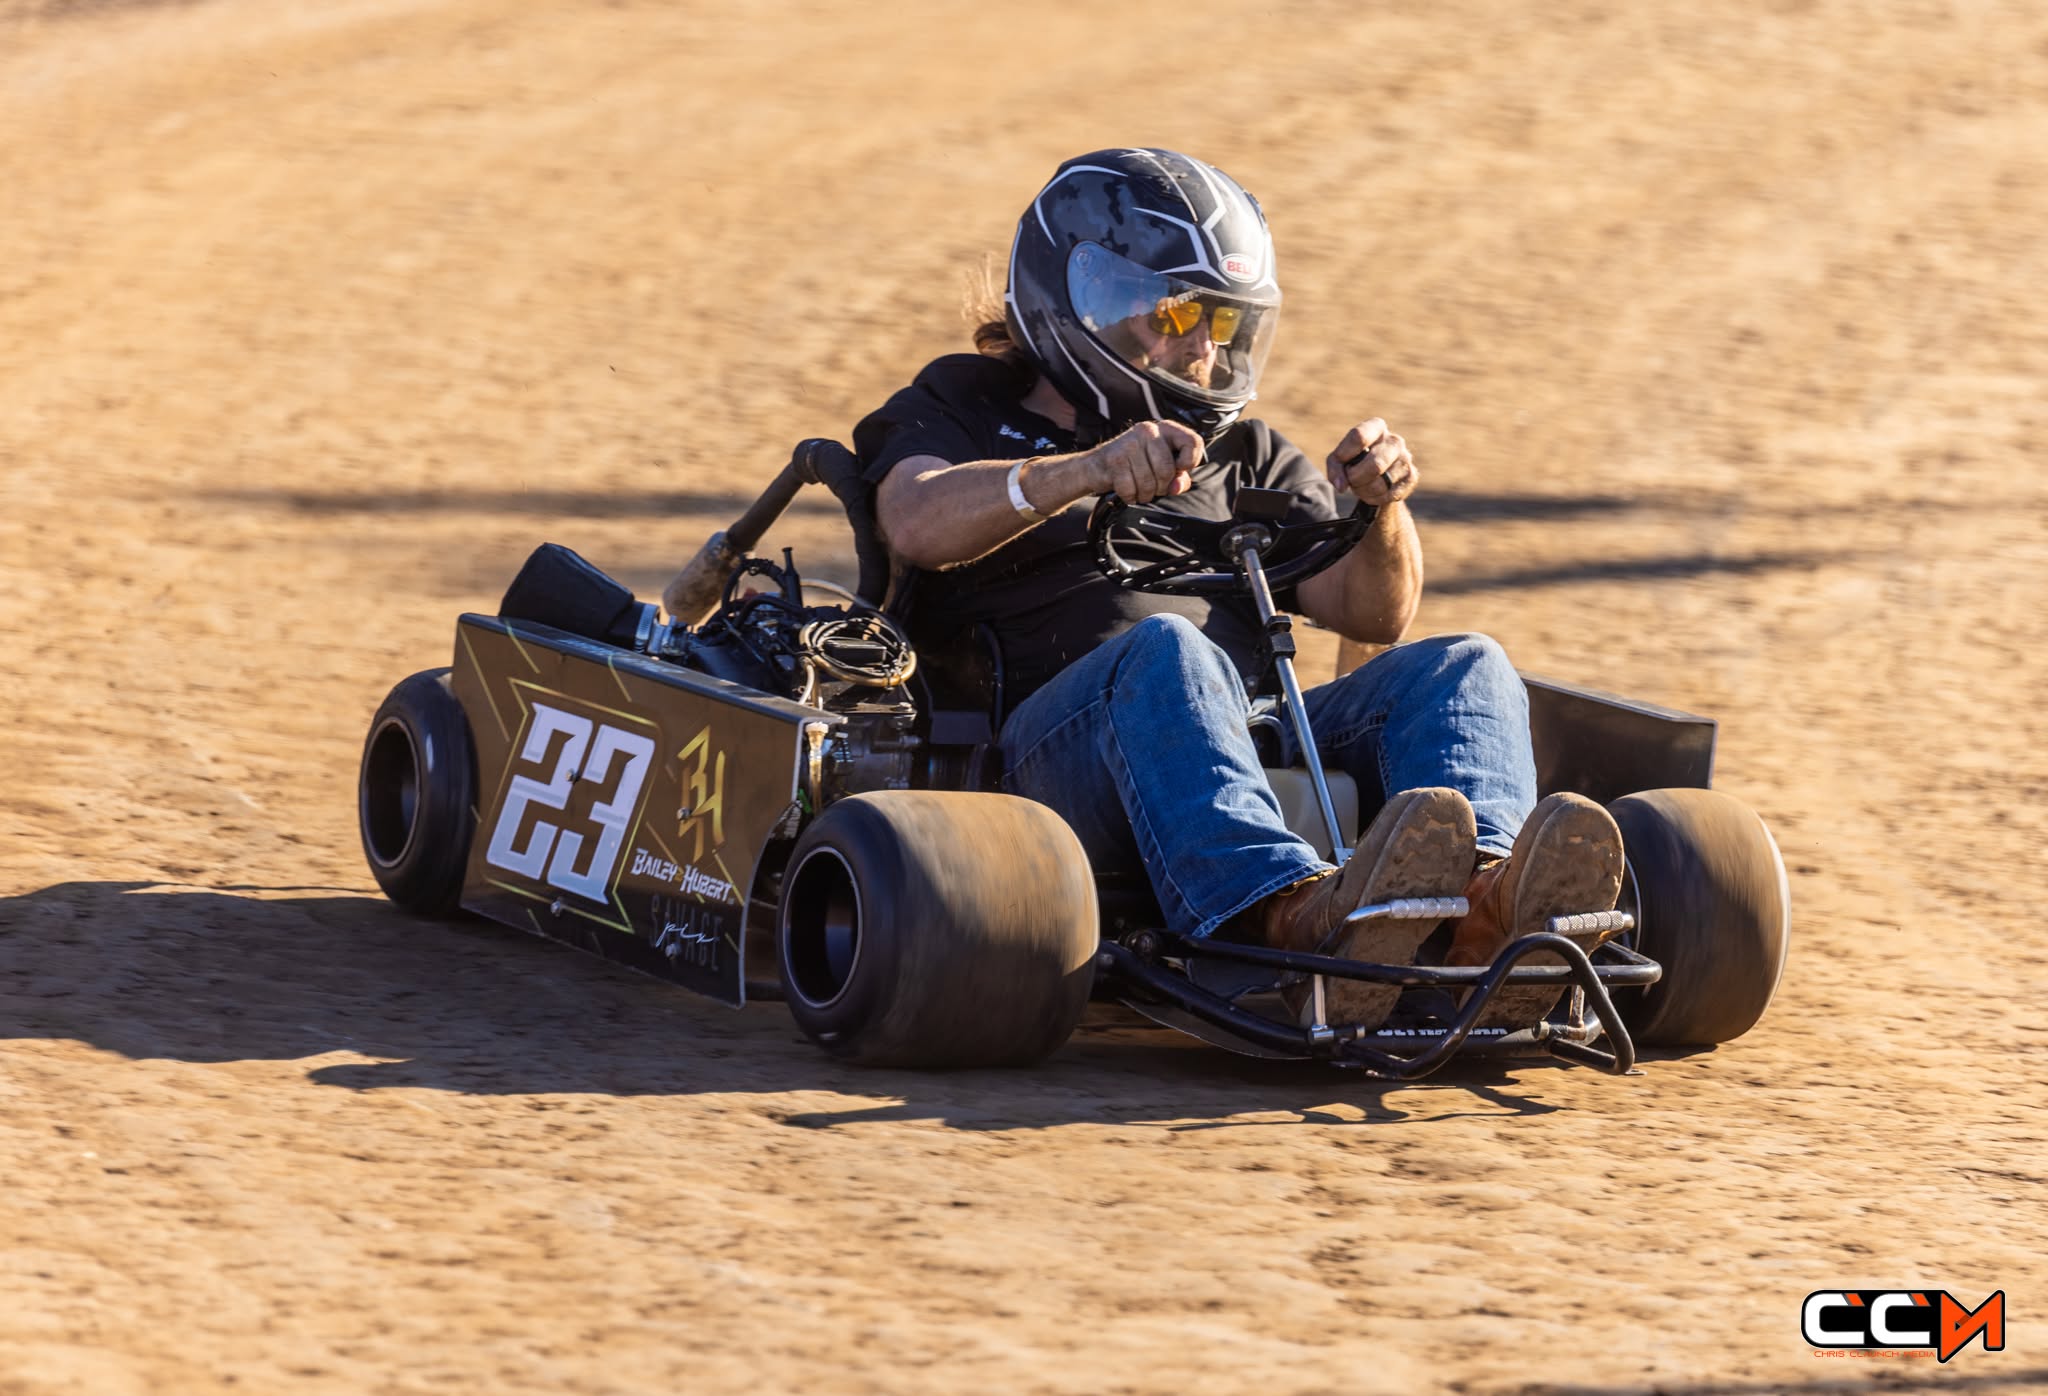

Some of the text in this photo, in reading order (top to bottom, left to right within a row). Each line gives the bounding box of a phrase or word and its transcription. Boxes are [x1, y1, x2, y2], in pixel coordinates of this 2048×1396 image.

[486, 702, 656, 904] 23
[631, 847, 734, 902] BAILEY HUBERT
